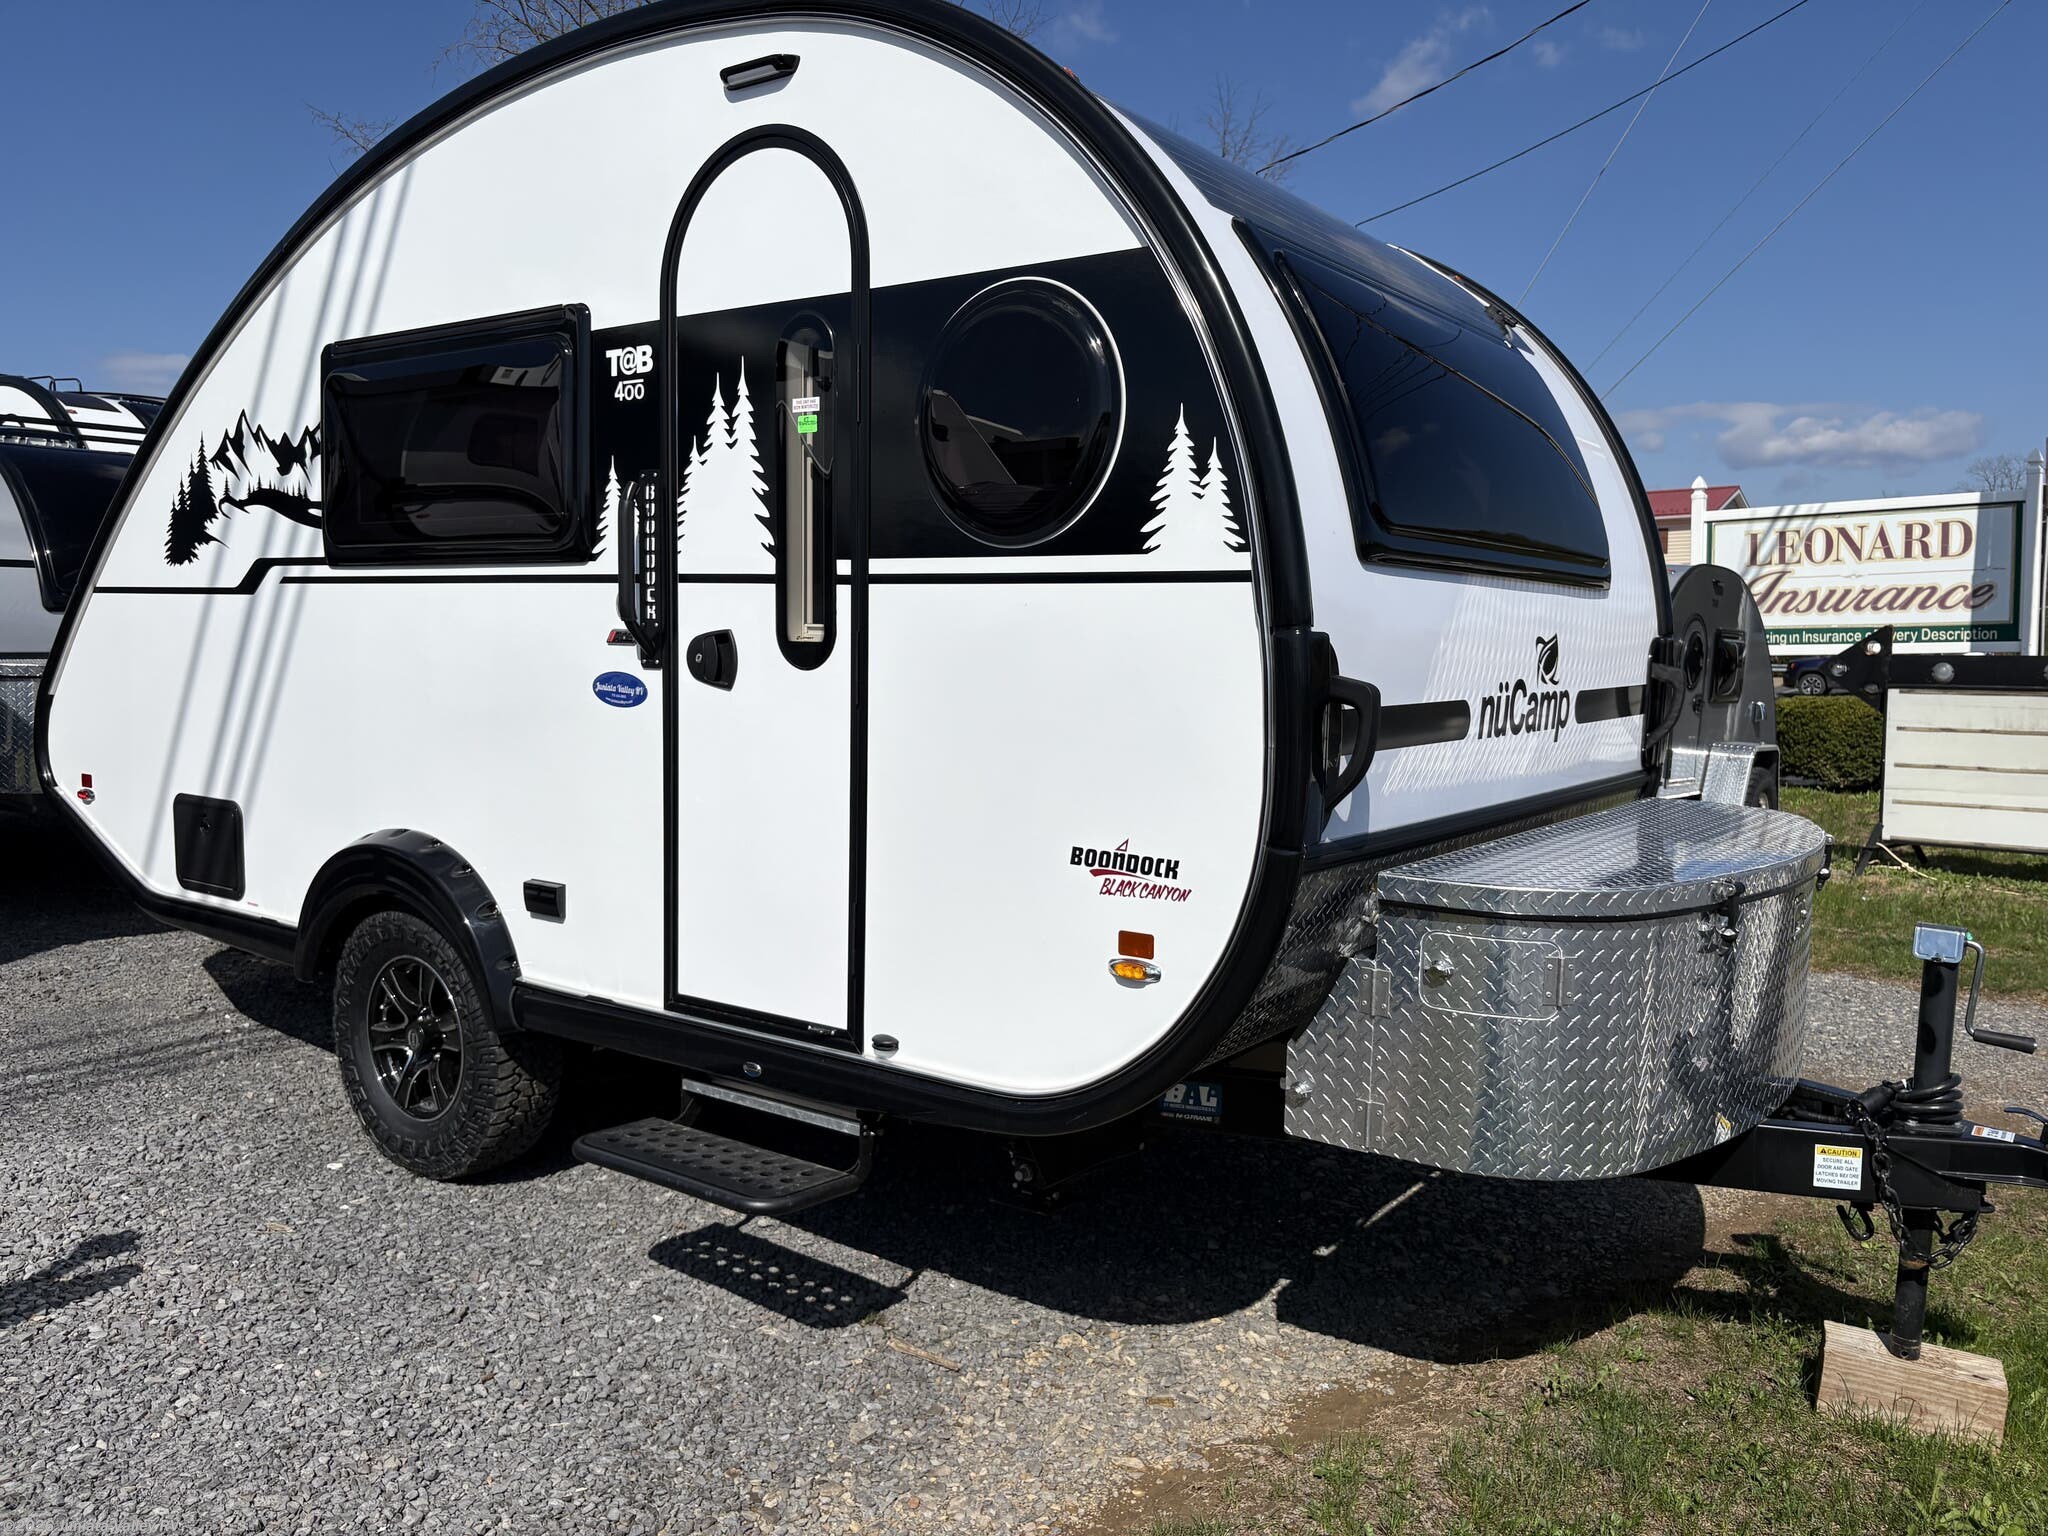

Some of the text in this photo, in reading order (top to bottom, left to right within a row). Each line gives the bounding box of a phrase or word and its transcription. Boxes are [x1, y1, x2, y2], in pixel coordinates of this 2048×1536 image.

[605, 344, 654, 377] T@B
[614, 380, 645, 402] 400
[1745, 518, 1975, 568] LEONARD
[1750, 570, 1997, 615] Insurance
[1803, 630, 1862, 643] Insurance
[1921, 627, 1998, 642] Description
[1477, 678, 1570, 743] nüCamp
[1070, 846, 1180, 880] BOONDOCK
[1099, 877, 1192, 902] BLACK CANYON
[1827, 1148, 1857, 1157] CAUTION
